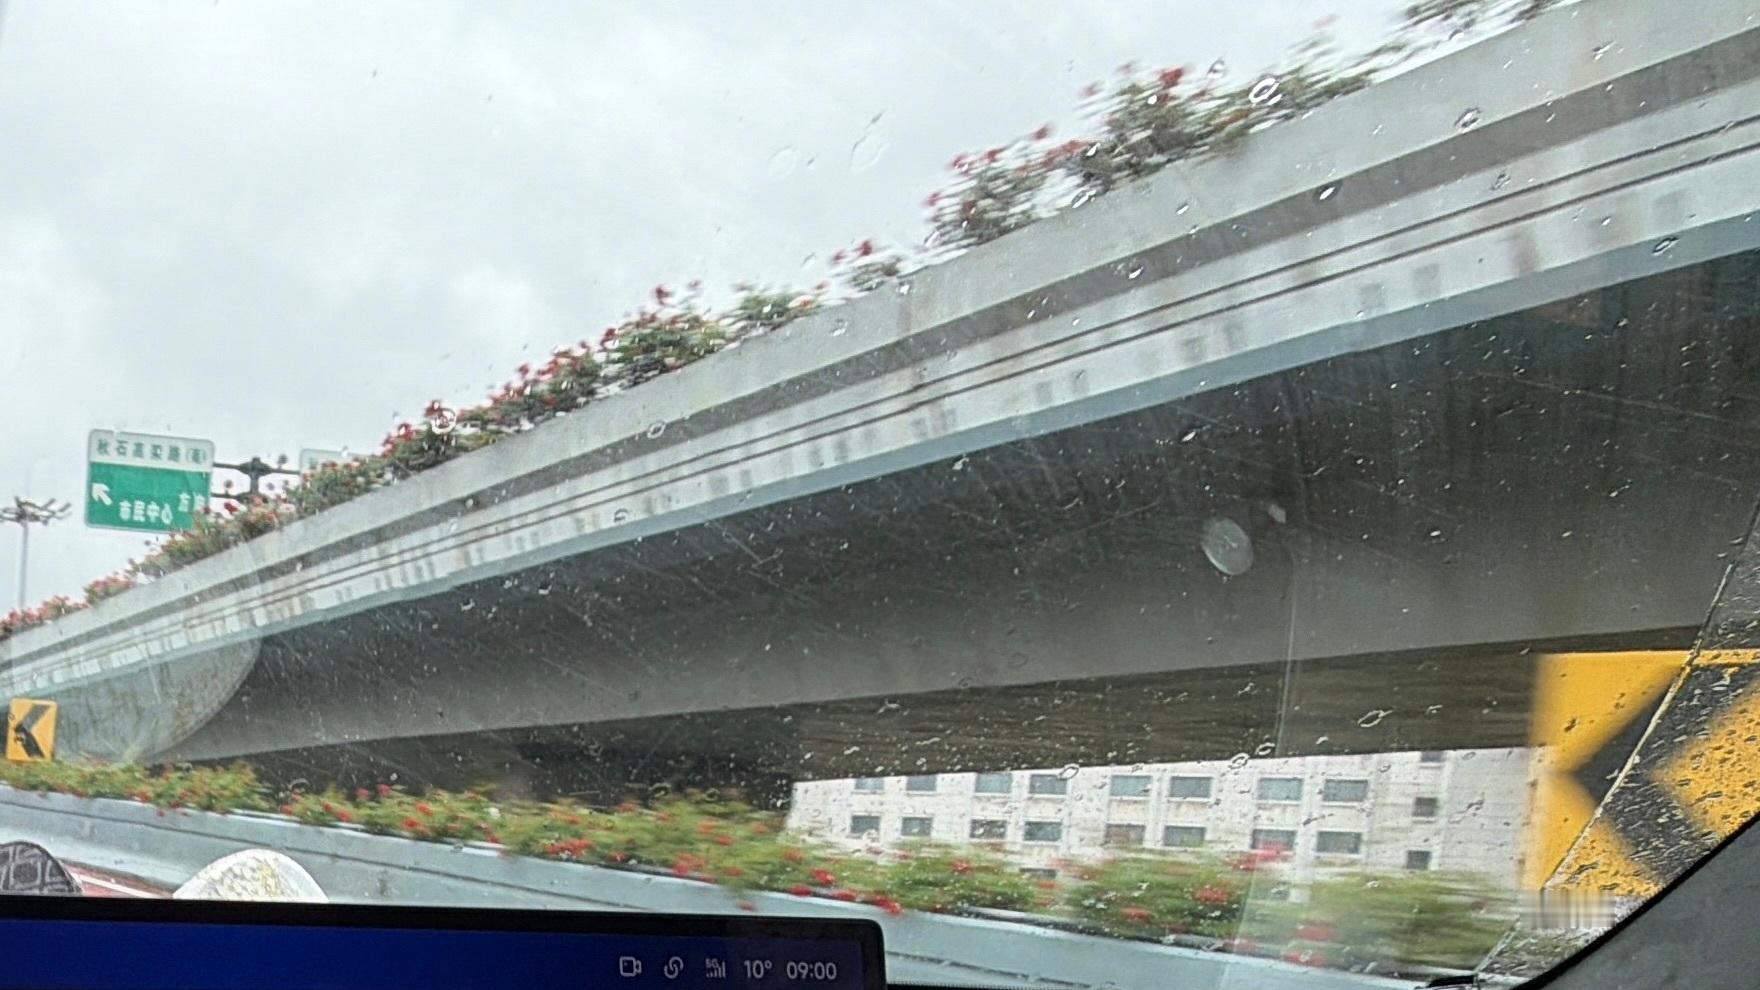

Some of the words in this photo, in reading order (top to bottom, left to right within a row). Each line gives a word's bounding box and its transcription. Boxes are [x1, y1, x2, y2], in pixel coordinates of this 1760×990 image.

[118, 499, 174, 525] 市民中心
[743, 960, 773, 979] 10°
[786, 961, 837, 980] 09:00
